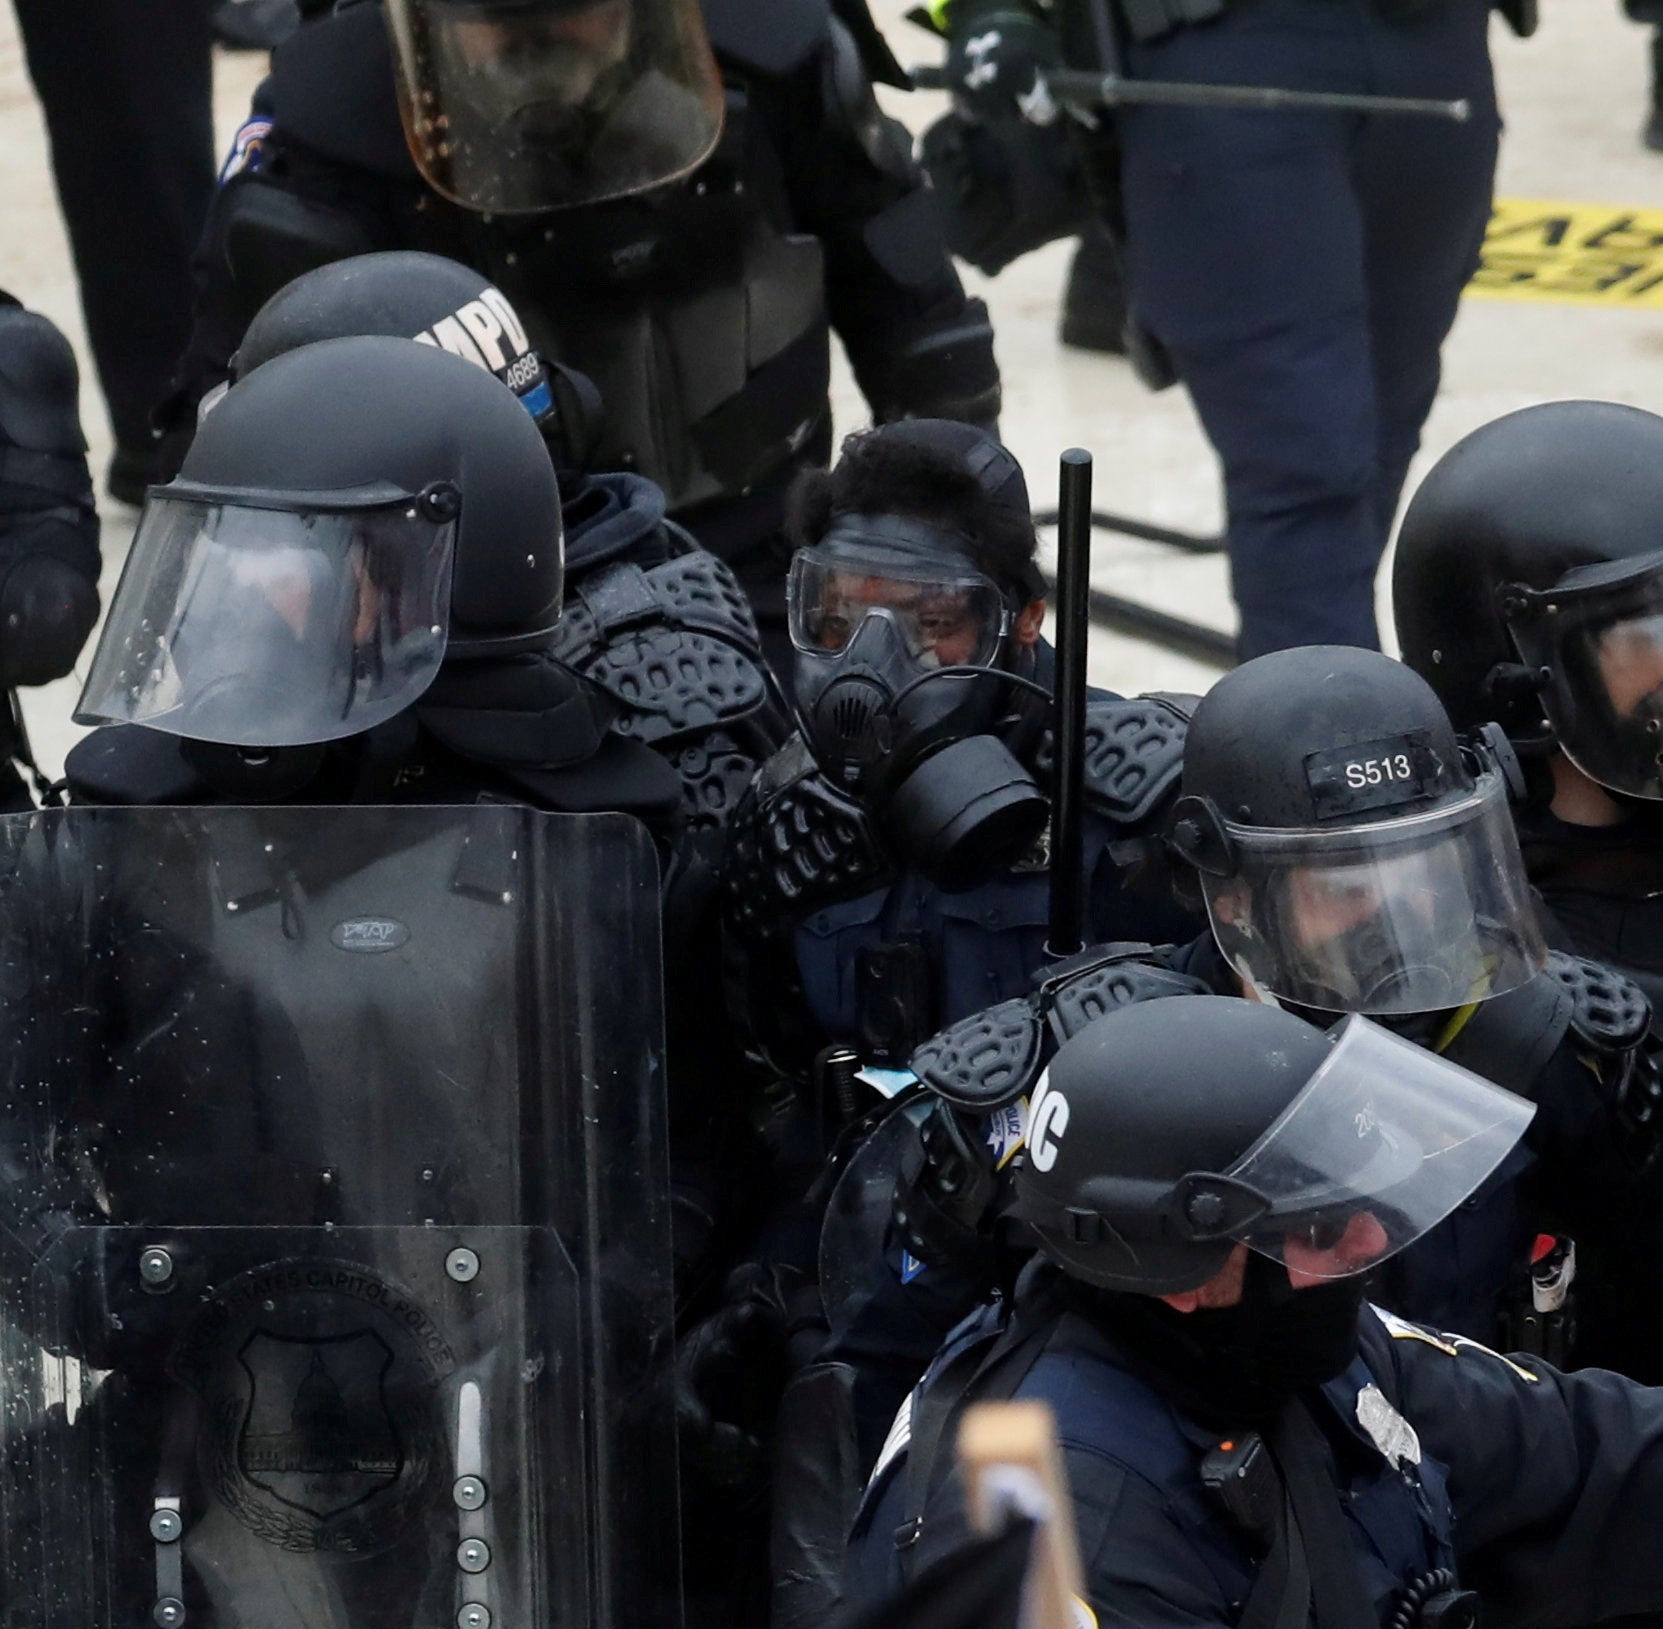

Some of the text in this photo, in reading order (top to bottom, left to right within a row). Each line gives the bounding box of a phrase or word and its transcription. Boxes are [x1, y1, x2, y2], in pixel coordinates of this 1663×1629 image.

[506, 353, 540, 390] 4689
[1345, 755, 1411, 789] S513
[306, 1269, 390, 1307] CAPITOL
[393, 1300, 453, 1365] POLICE
